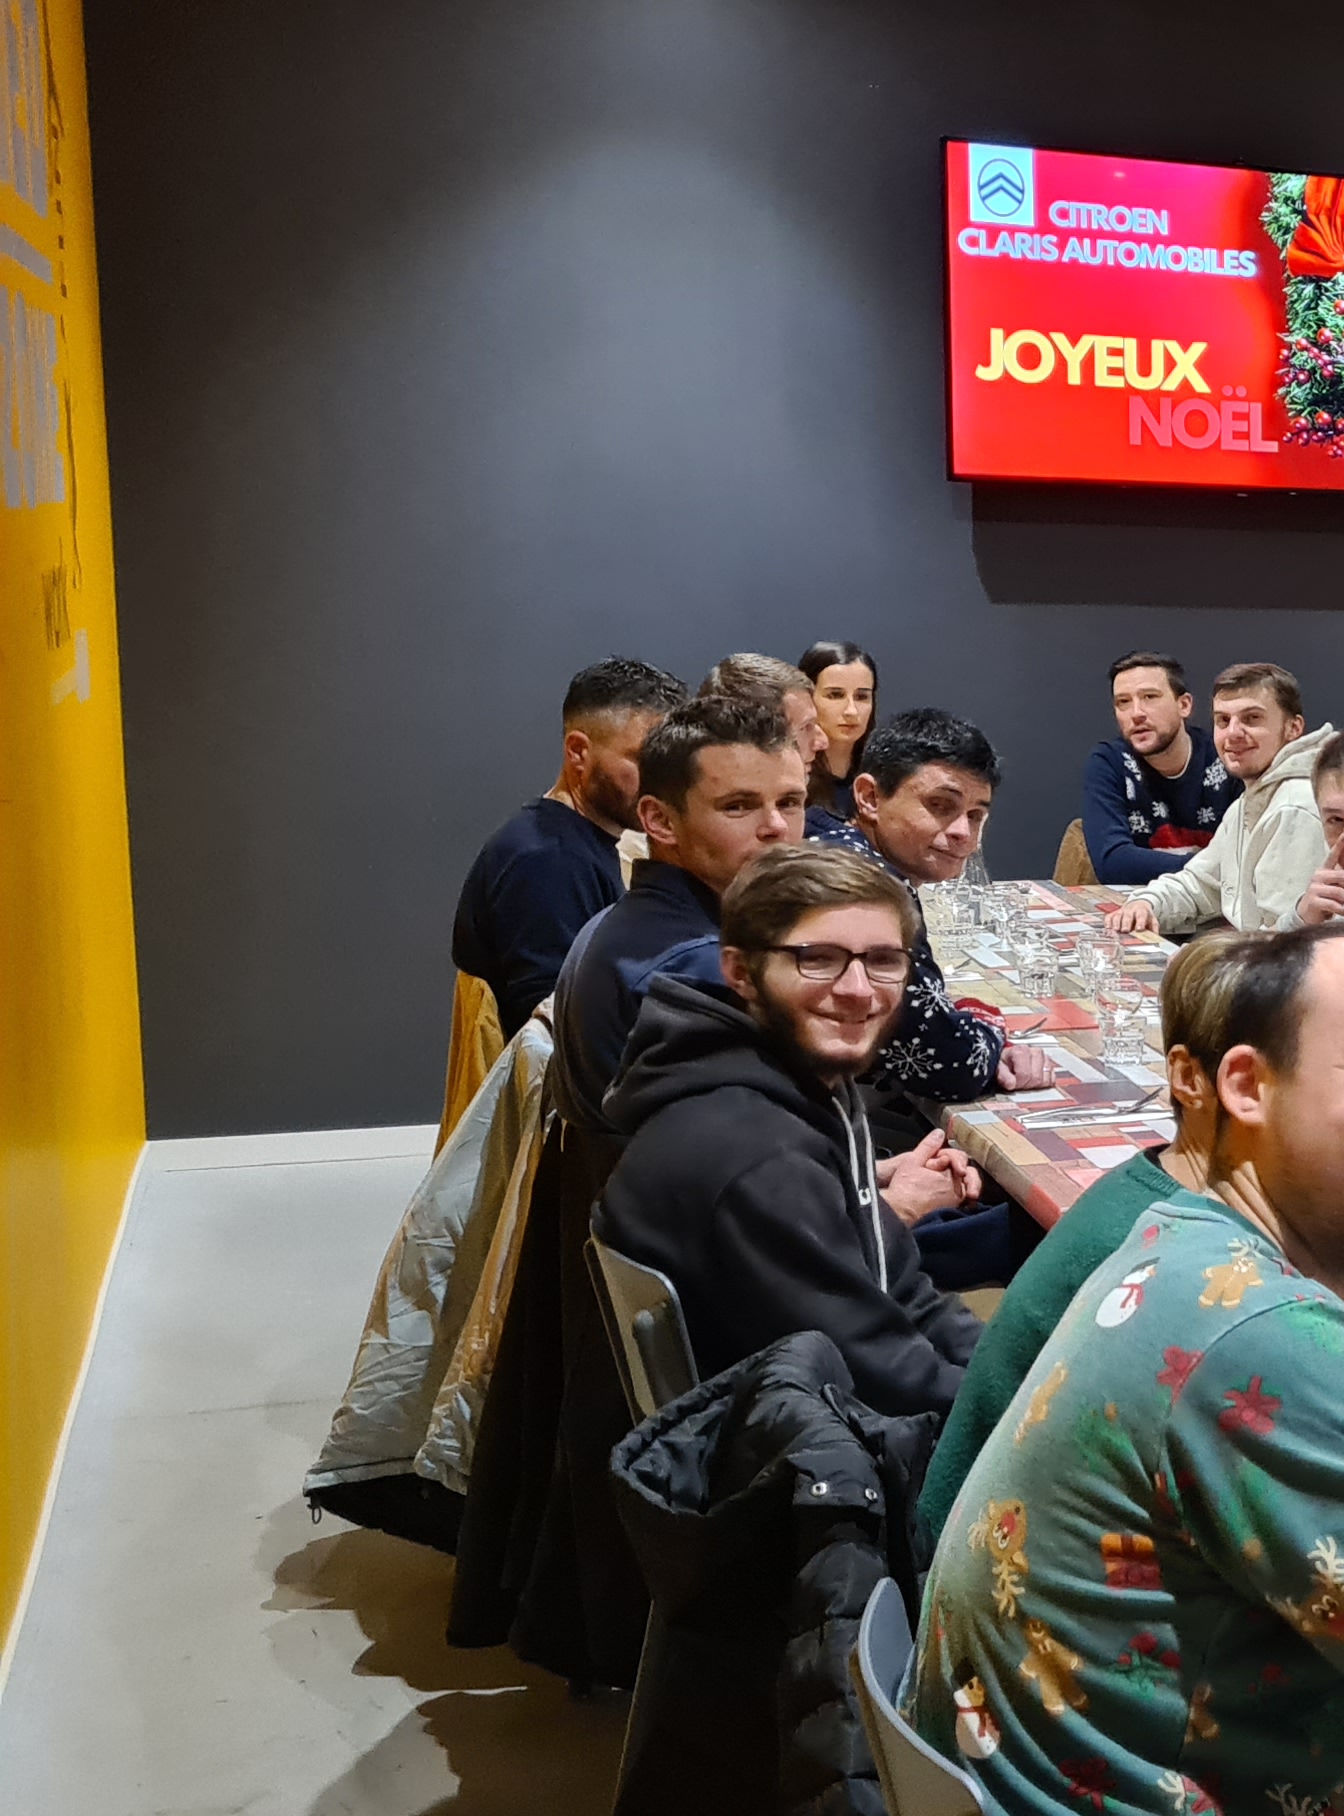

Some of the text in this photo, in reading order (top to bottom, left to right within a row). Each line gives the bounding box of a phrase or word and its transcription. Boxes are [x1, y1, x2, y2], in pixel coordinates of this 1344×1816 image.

[1048, 200, 1169, 235] CITROEN
[957, 228, 1257, 277] CLARIS AUTOMOBILES
[975, 328, 1211, 394] JOYEUX
[1128, 385, 1278, 453] NOËL
